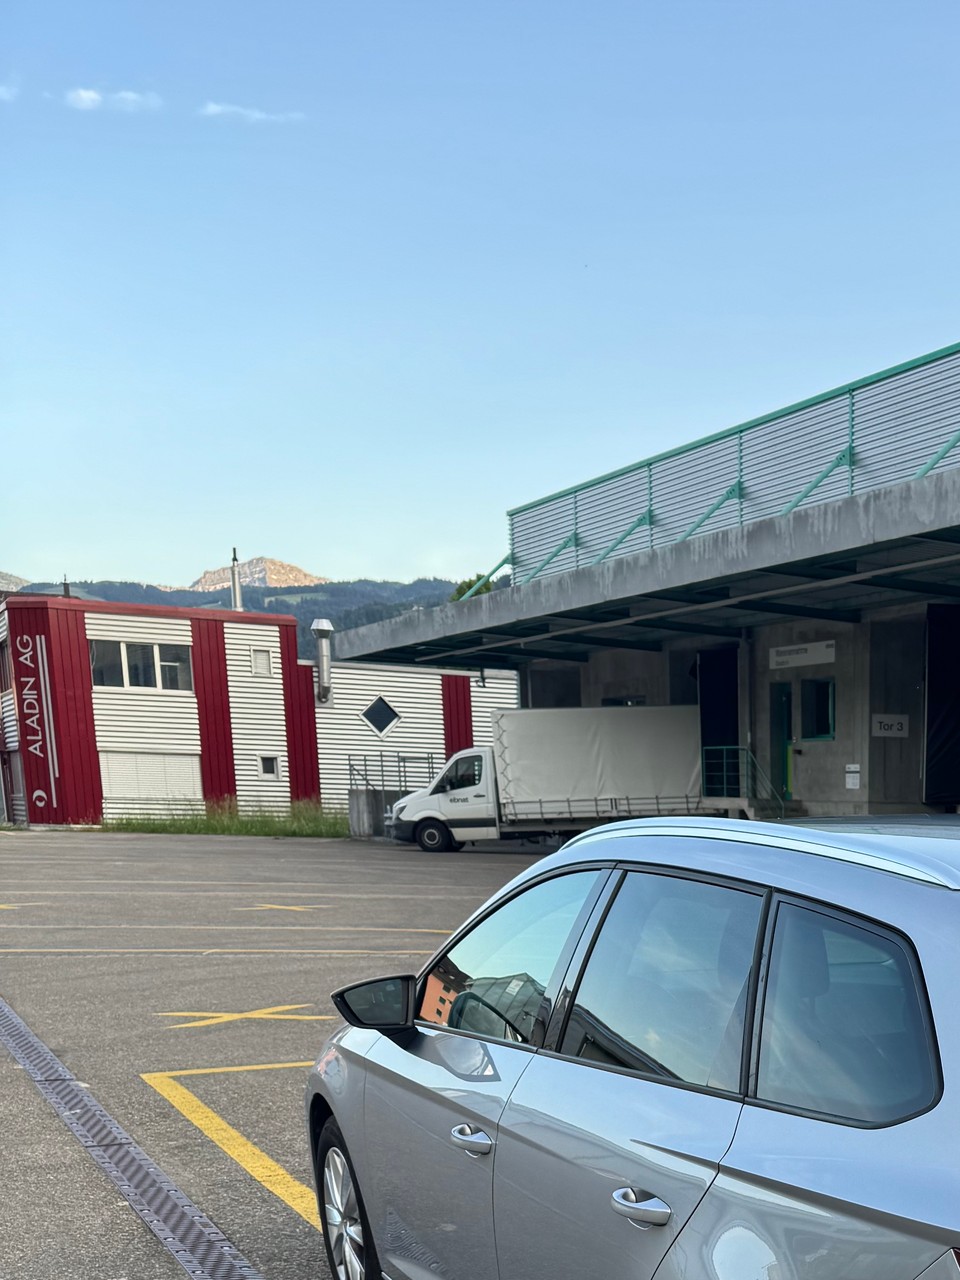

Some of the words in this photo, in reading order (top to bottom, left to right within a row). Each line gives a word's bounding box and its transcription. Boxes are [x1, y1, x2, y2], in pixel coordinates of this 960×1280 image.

[16, 634, 35, 668] AG
[20, 677, 44, 758] ALADIN
[878, 721, 894, 731] Tor
[896, 721, 904, 732] 3
